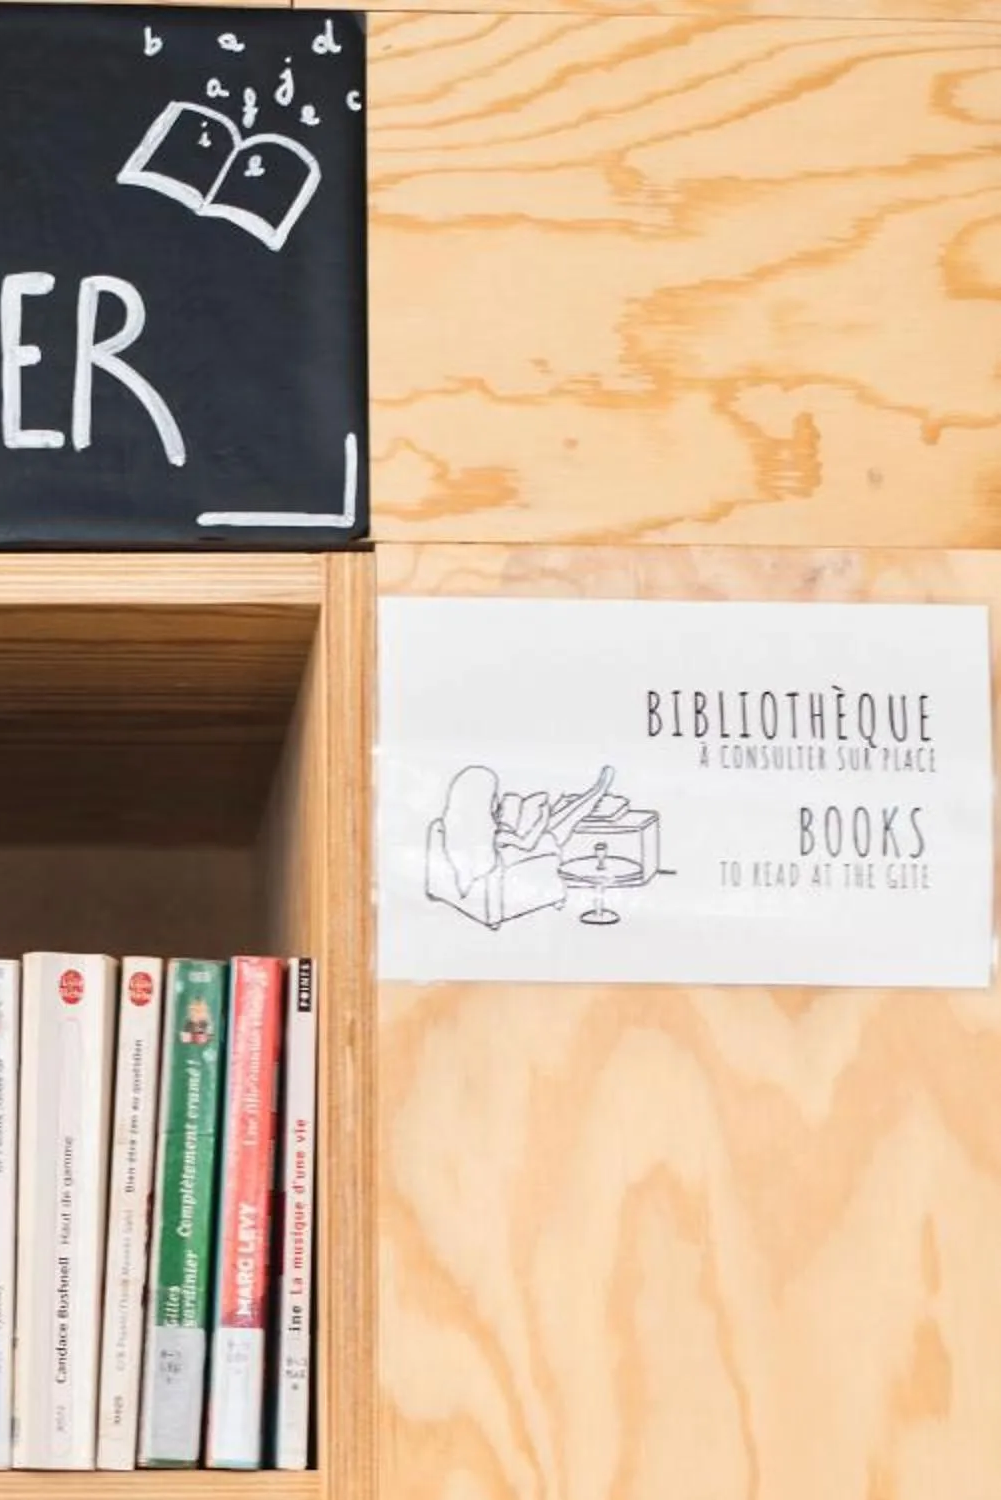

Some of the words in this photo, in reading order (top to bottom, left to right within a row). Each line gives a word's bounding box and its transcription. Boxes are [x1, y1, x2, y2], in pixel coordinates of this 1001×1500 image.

[143, 26, 163, 56] b
[312, 18, 342, 54] d
[206, 77, 230, 98] a
[346, 90, 362, 111] c
[300, 103, 322, 126] e
[647, 684, 932, 749] BIBLIOTHÈQUE
[720, 744, 828, 771] CONSULTER
[838, 746, 872, 772] SUR
[882, 746, 937, 773] PLACE
[799, 805, 926, 860] BOOKS
[719, 861, 742, 888] TO
[752, 861, 800, 888] READ
[811, 862, 832, 888] AT
[843, 862, 876, 889] THE
[298, 962, 311, 1009] POINTS
[293, 1119, 307, 1144] vie
[62, 1135, 76, 1187] gamme
[290, 1150, 306, 1194] d'une
[60, 1190, 73, 1207] de
[176, 1123, 199, 1238] Complètement
[59, 1212, 72, 1245] Haut
[238, 1202, 258, 1253] LEVY
[290, 1199, 308, 1270] musique
[55, 1256, 71, 1319] Bushnell
[237, 1256, 256, 1316] MARC
[289, 1274, 303, 1295] La
[287, 1305, 302, 1332] ine
[54, 1322, 71, 1385] Candace
